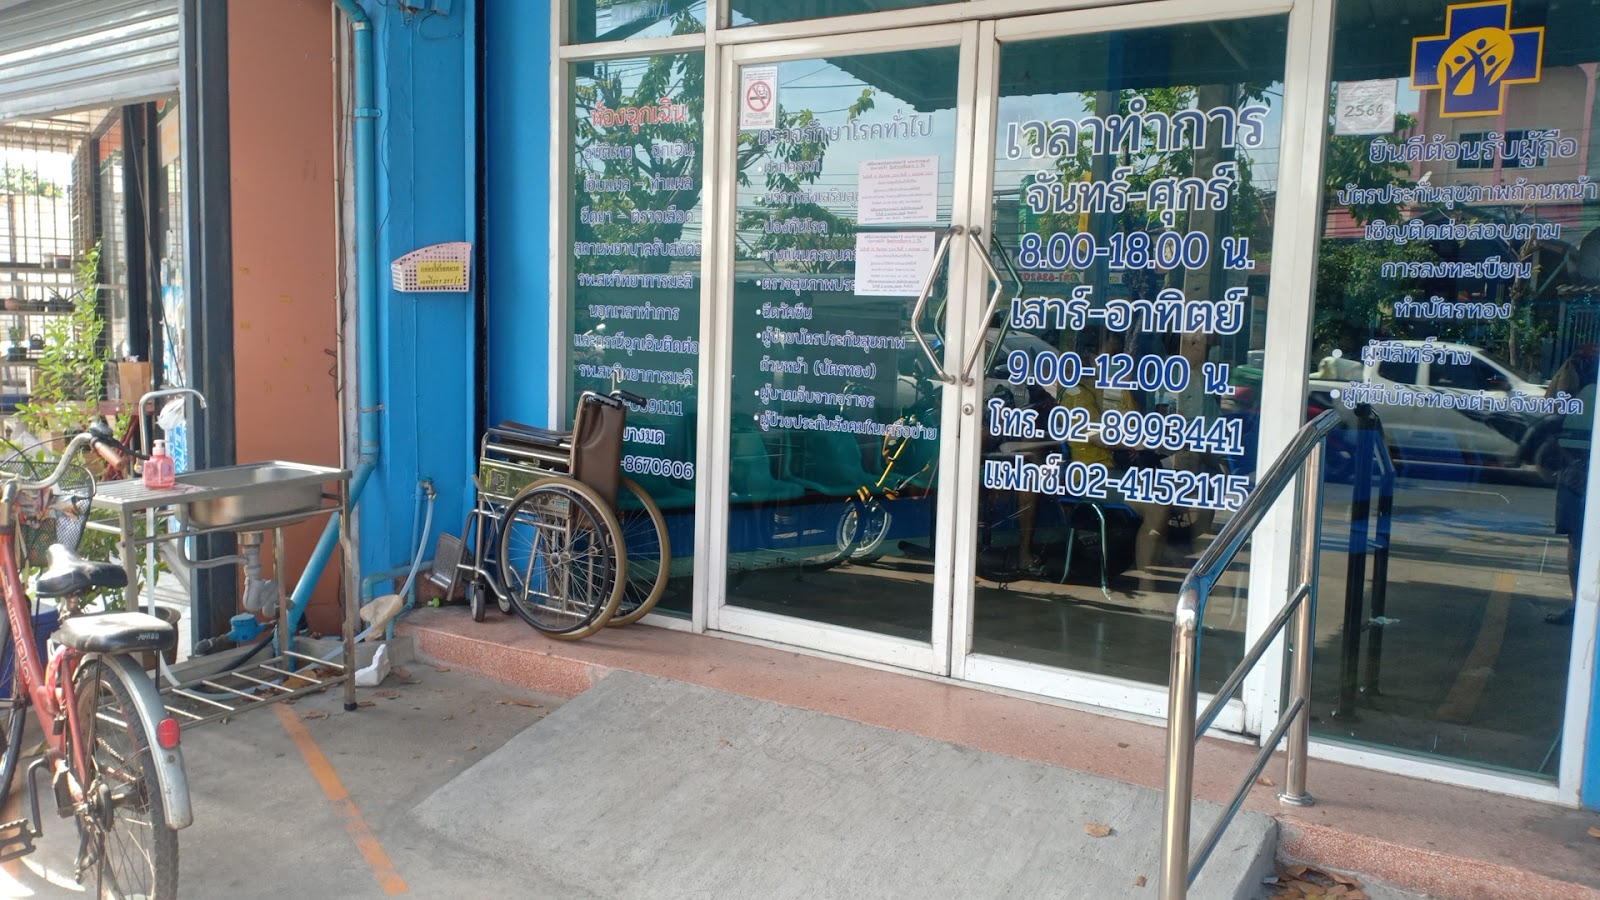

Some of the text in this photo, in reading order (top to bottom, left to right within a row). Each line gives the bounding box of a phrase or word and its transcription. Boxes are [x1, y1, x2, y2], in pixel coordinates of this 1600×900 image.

[590, 97, 686, 135] ห้องฉุกเฉิน
[759, 108, 934, 145] ตรวจรักษาโรคทั่วไป
[1006, 96, 1270, 161] เวลาทำการ
[584, 141, 632, 167] อุบัติเหตุ
[652, 139, 694, 164] ฉุกเฉิน
[1369, 129, 1578, 168] ยินดีต้อนรับผู้ถือ
[763, 155, 821, 174] ฝากครรภ์
[584, 172, 631, 192] เย็บแผล
[649, 172, 693, 191] ทำแผล
[1026, 161, 1236, 228] จันทร์-ศุกร์
[1337, 176, 1598, 210] บัตรประกันสุขภาพถ้วนหน้า
[580, 205, 613, 224] ฉีดยา
[631, 205, 693, 224] ตรวจเลือด
[763, 214, 828, 234] ป้องกันโรค
[1364, 219, 1561, 246] เชิญติดต่อสอบถาม
[574, 237, 701, 259] สถานพยาบาลรับส่งต่อ
[1019, 231, 1210, 270] 8.00-18.00
[1222, 236, 1255, 270] น.
[578, 269, 693, 289] รพ.สหวิทยาการมะลิ
[1381, 256, 1532, 279] การลงทะเบียน
[588, 301, 680, 320] นอกเวลาทำการ
[761, 301, 812, 320] ฉีดวัคซีน
[1010, 285, 1248, 335] เสาร์-อาทิตย์
[1394, 295, 1512, 319] ทำบัตรทอง
[573, 331, 699, 356] และกรณีฉุกเฉินติดต่อ
[761, 326, 906, 354] ผู้ป่วยบัตรประกันสุขภาพ
[1361, 336, 1472, 368] ผู้มีสิทธิ์ว่าง
[760, 355, 877, 379] ถ้วนหน้า (บัตรทอง)
[1007, 350, 1235, 395] 9.00-12.00 น.
[760, 382, 876, 408] ผู้บาดเจ็บจากจราจร
[1341, 378, 1583, 415] ผู้ที่มีบัตรทองต่างจังหวัด
[759, 409, 938, 441] ผู้ป่วยประกันสังคมในเครือข่าย
[989, 397, 1245, 455] โทร. 02-8993441
